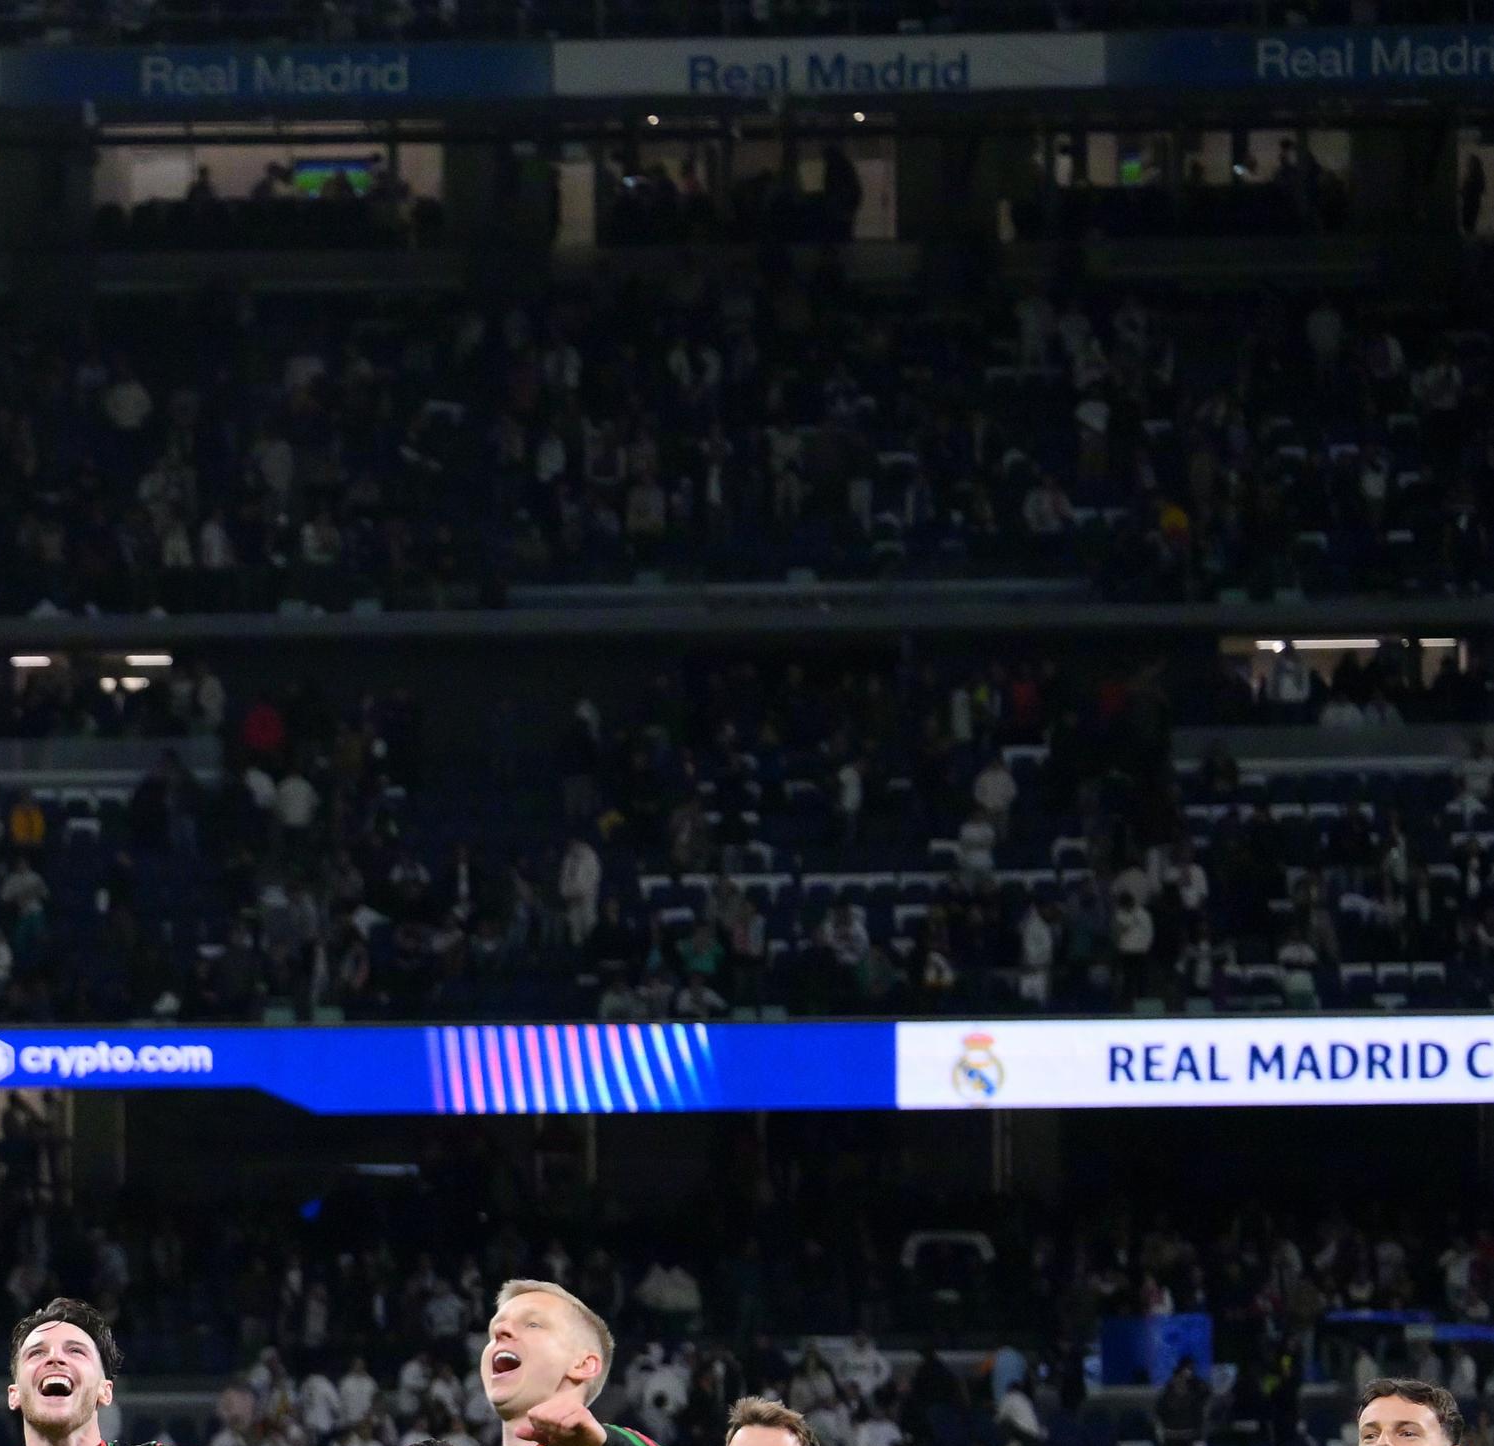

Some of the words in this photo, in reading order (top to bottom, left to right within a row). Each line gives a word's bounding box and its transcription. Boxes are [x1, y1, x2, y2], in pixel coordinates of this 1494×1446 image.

[139, 55, 237, 96] Real
[253, 53, 409, 94] Madrid
[687, 54, 789, 95] Real
[806, 51, 969, 91] Madrid
[1256, 36, 1355, 79] Real
[18, 1040, 214, 1079] crypto.com
[1109, 1045, 1230, 1083] REAL
[1247, 1041, 1450, 1081] MADRID
